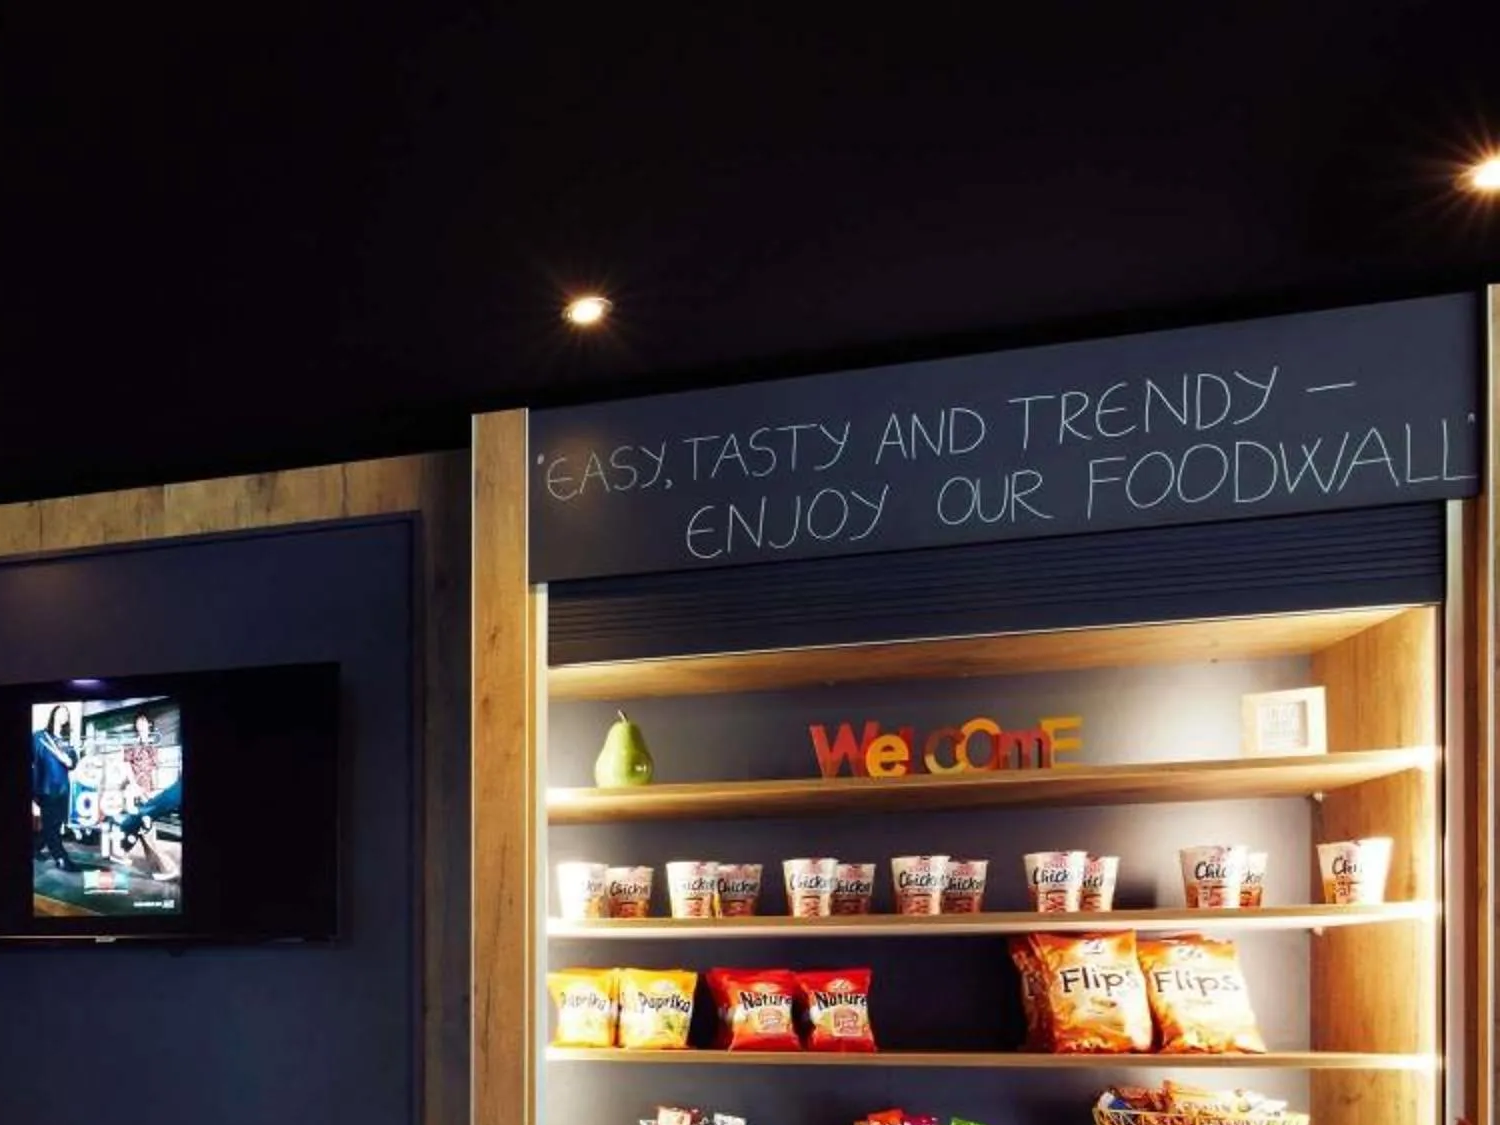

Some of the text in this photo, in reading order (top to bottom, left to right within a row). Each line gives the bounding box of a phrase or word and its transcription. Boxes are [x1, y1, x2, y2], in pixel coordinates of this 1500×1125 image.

[683, 421, 851, 480] TASTY
[875, 407, 986, 465] AND
[1008, 366, 1279, 450] TRENDY
[686, 484, 889, 559] ENJOY
[937, 470, 1055, 525] OUR
[76, 784, 140, 827] get
[1153, 970, 1241, 997] Flips
[637, 991, 691, 1014] Paprika
[739, 991, 792, 1011] Nature
[814, 991, 868, 1011] Nature
